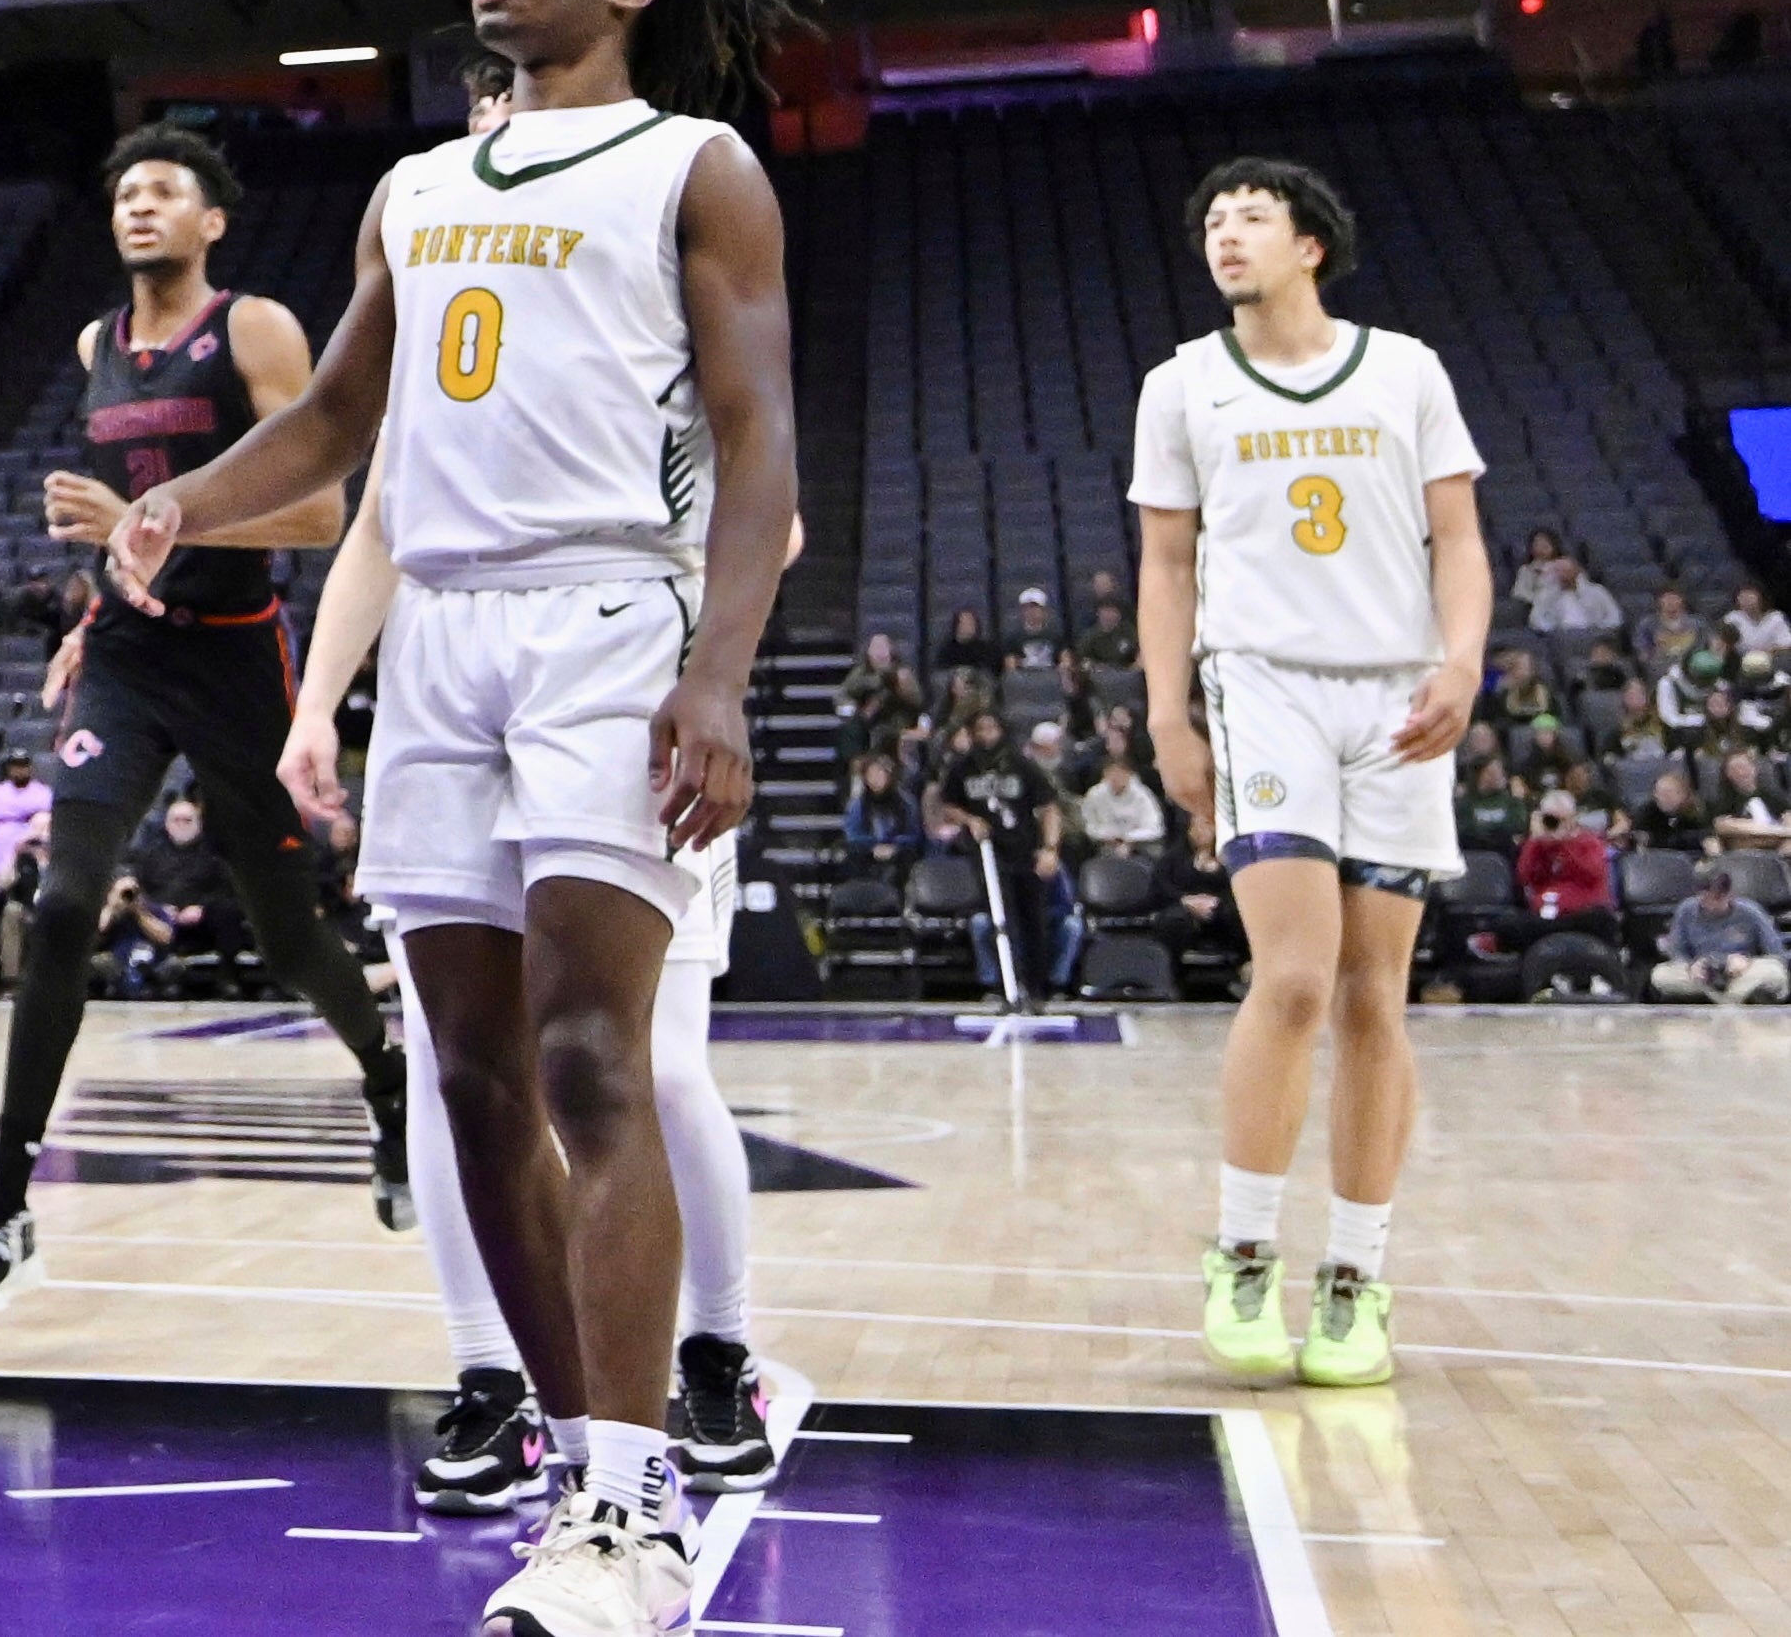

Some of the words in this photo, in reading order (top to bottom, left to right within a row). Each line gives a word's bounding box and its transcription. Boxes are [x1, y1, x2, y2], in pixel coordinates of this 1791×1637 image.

[405, 224, 584, 269] MONTEREY
[436, 286, 503, 402] 0
[1235, 426, 1382, 462] MONTEREY
[1287, 475, 1348, 555] 3
